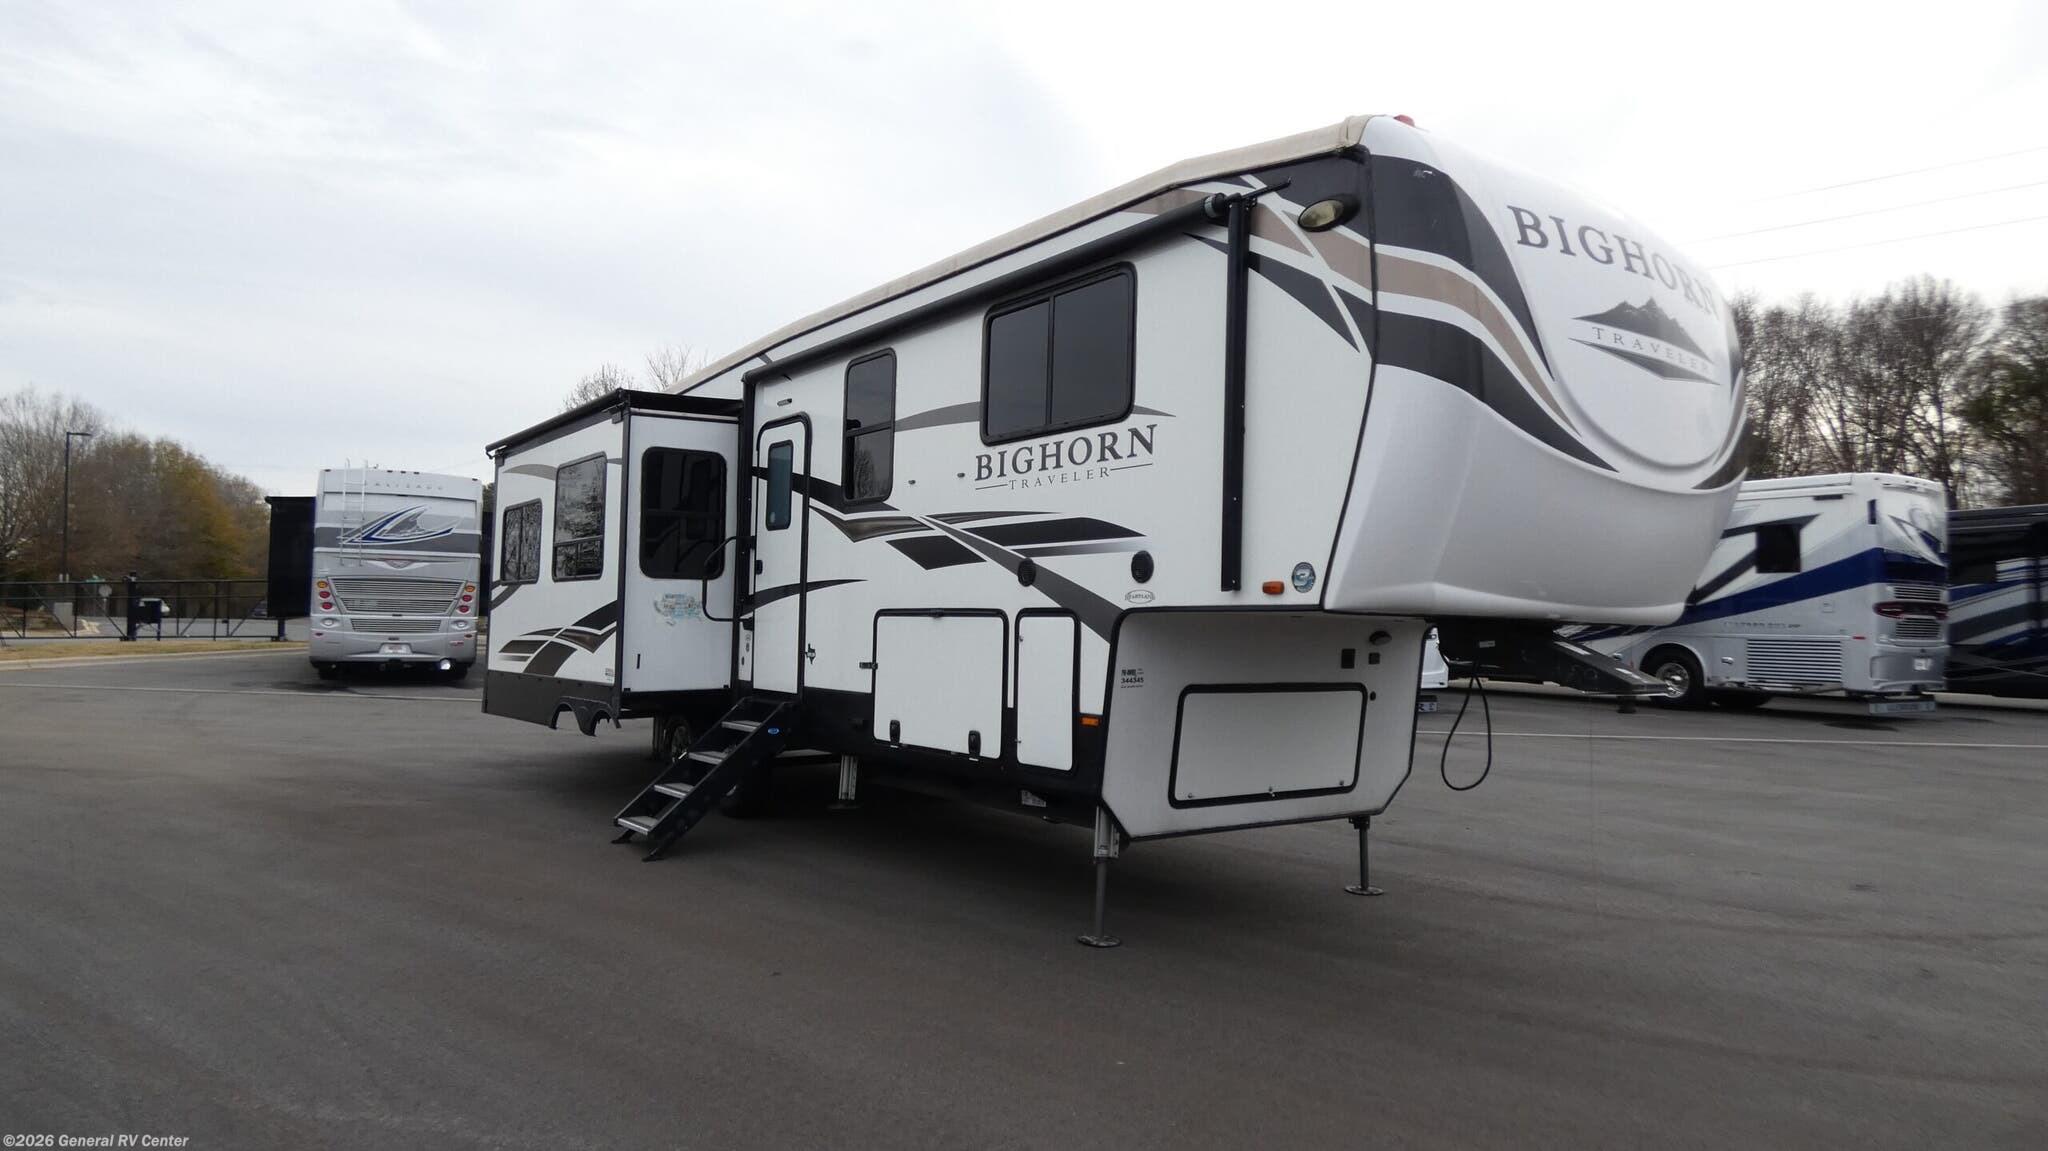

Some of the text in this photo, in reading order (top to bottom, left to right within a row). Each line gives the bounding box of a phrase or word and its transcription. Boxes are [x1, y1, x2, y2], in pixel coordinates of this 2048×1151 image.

[1506, 204, 1721, 321] BIGHORN
[1591, 326, 1710, 373] TRAVELER
[974, 423, 1158, 482] BIGHORN
[1008, 466, 1111, 491] TRAVELER
